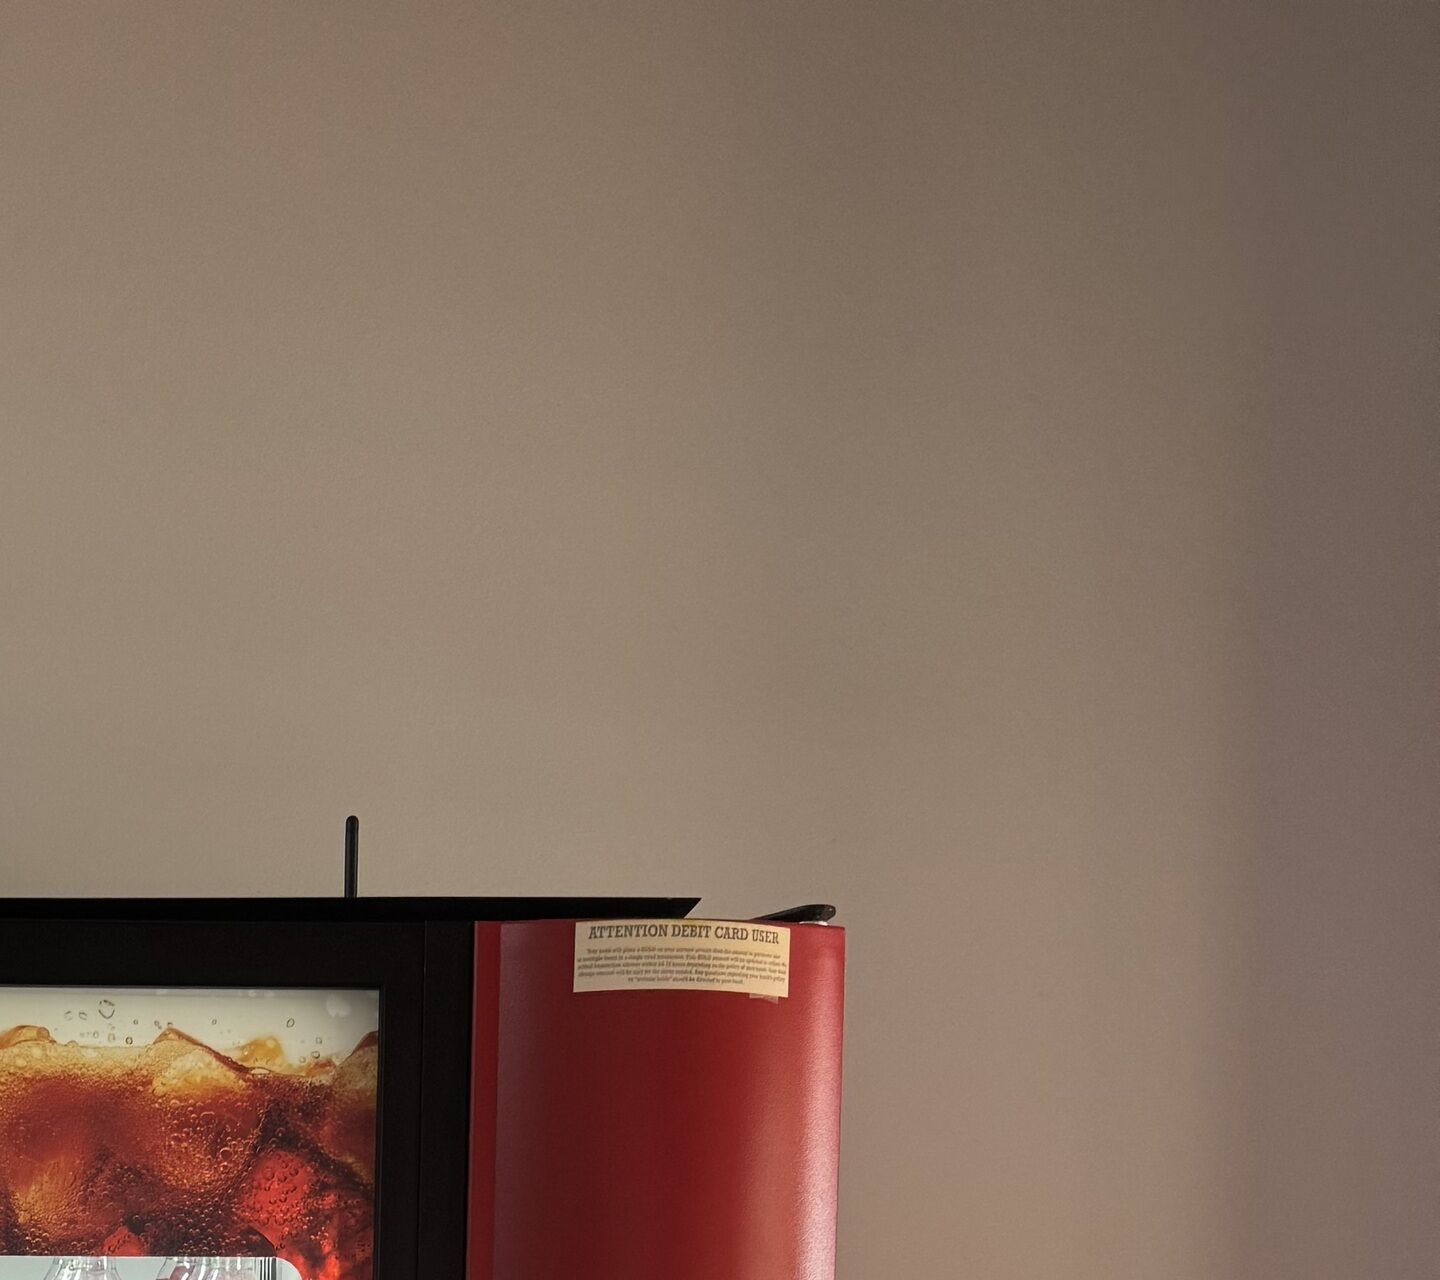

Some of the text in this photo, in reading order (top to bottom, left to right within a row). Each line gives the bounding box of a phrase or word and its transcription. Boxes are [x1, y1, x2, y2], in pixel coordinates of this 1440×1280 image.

[588, 923, 779, 944] ATTENTION DEBIT CARD USER
